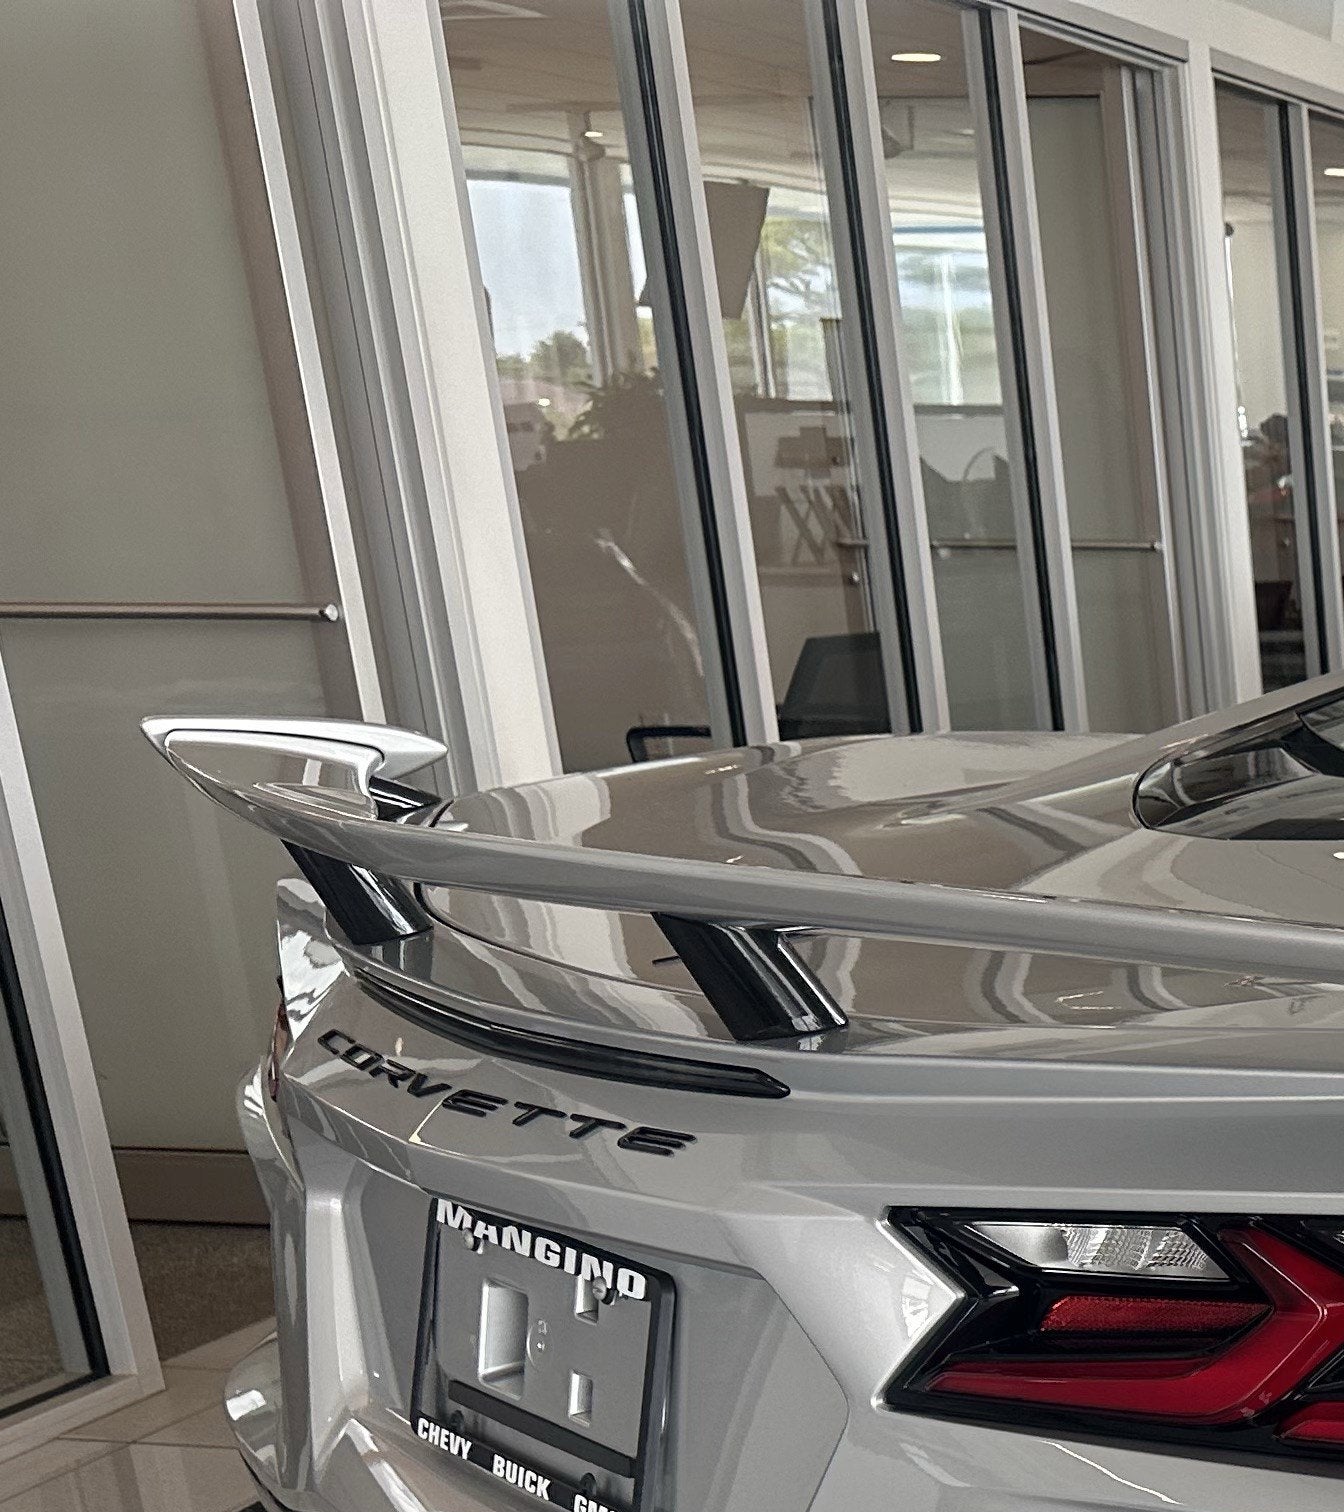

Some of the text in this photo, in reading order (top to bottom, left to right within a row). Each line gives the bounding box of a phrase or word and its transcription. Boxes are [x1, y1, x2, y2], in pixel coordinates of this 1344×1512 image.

[317, 1028, 698, 1157] CORVETTE
[436, 1198, 646, 1300] MANGINO
[417, 1417, 473, 1461] CHEVY
[492, 1453, 551, 1501] BUICK
